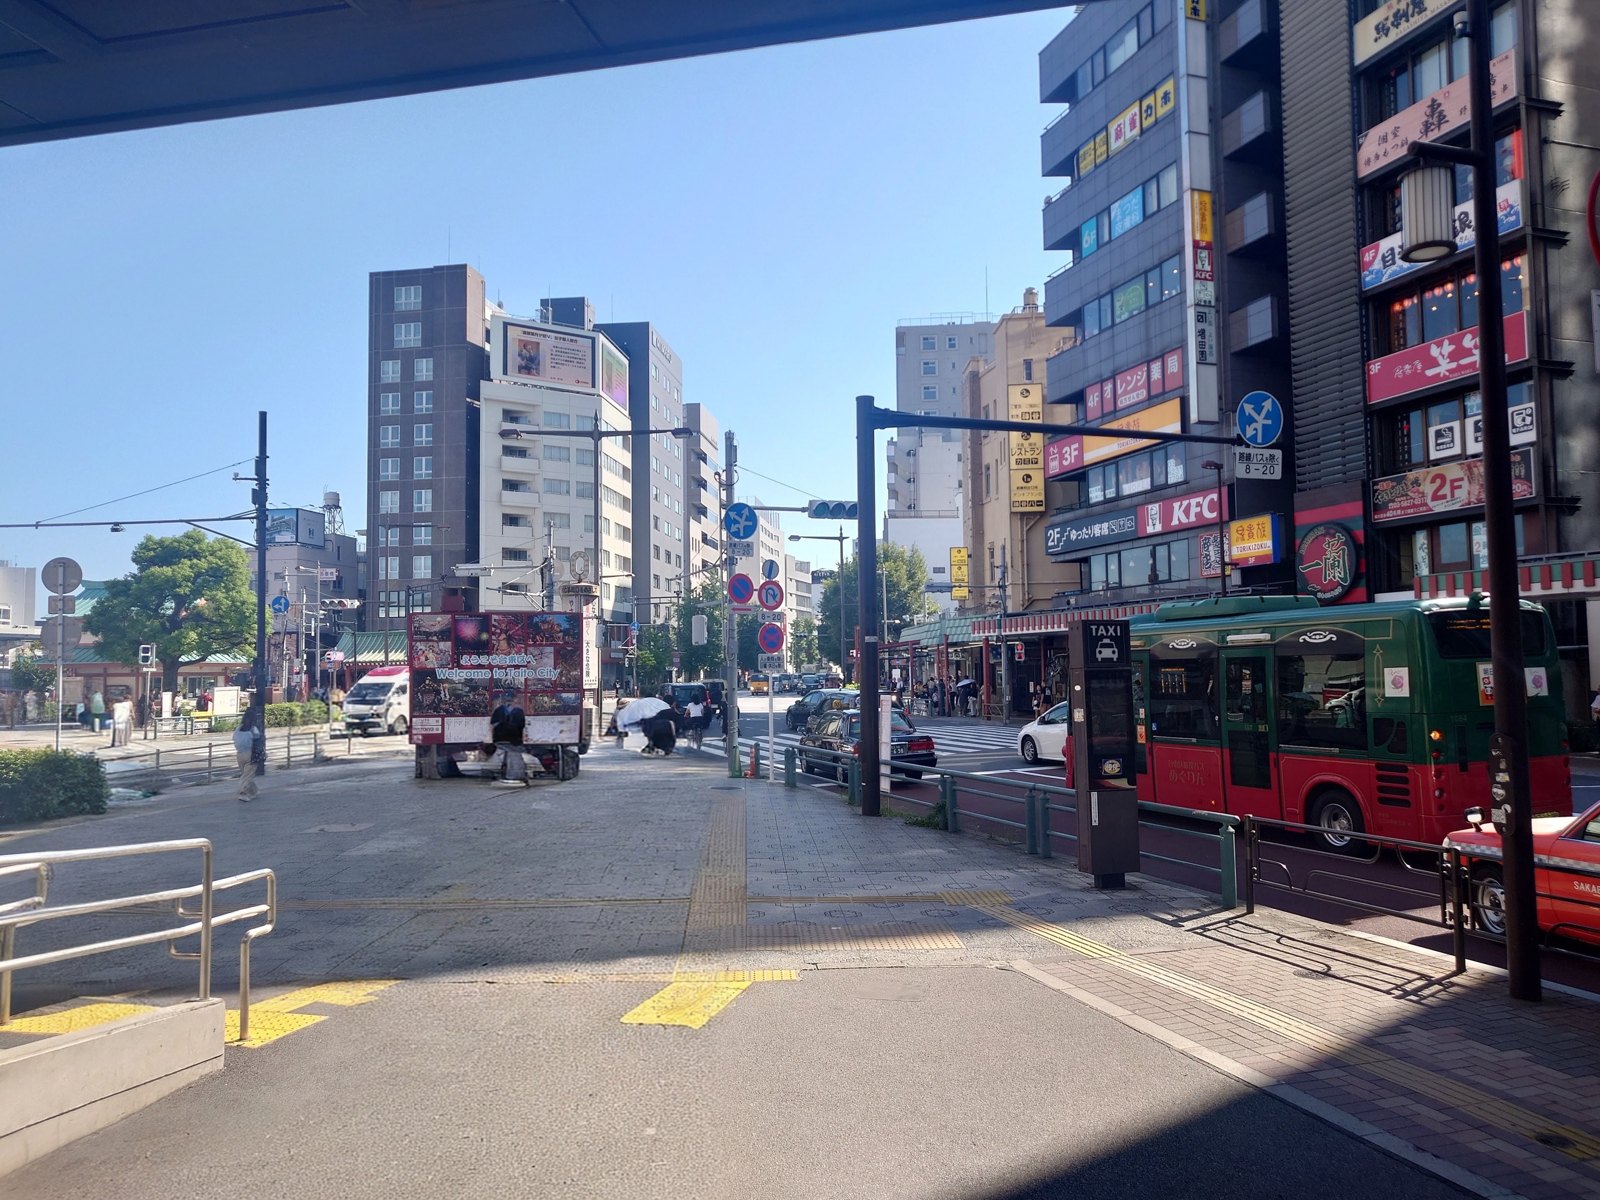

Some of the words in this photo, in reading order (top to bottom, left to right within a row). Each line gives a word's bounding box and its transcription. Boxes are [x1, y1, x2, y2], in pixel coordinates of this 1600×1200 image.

[1083, 231, 1097, 248] 6F
[1363, 249, 1376, 262] 4F
[1195, 270, 1213, 280] KFC
[1369, 362, 1382, 375] 3F
[1087, 392, 1100, 408] 4F
[1011, 447, 1042, 457] レストラン
[1062, 442, 1079, 466] 3F
[1238, 451, 1280, 463] 路線バスを除く
[1429, 472, 1465, 502] 2F
[1170, 493, 1218, 526] KFC
[1047, 528, 1061, 547] 2F
[1069, 521, 1109, 541] ゆったり客席
[1236, 543, 1268, 553] TORIKIZOKU
[1299, 533, 1350, 585] 一蘭
[761, 613, 782, 621] 8-20
[1090, 625, 1120, 636] TAXI
[461, 654, 536, 666] ようこそ台東区へ
[436, 668, 491, 679] Welcome
[493, 668, 505, 679] to
[507, 667, 535, 679] Taito
[536, 667, 560, 681] City
[1168, 769, 1206, 786] めぐりん
